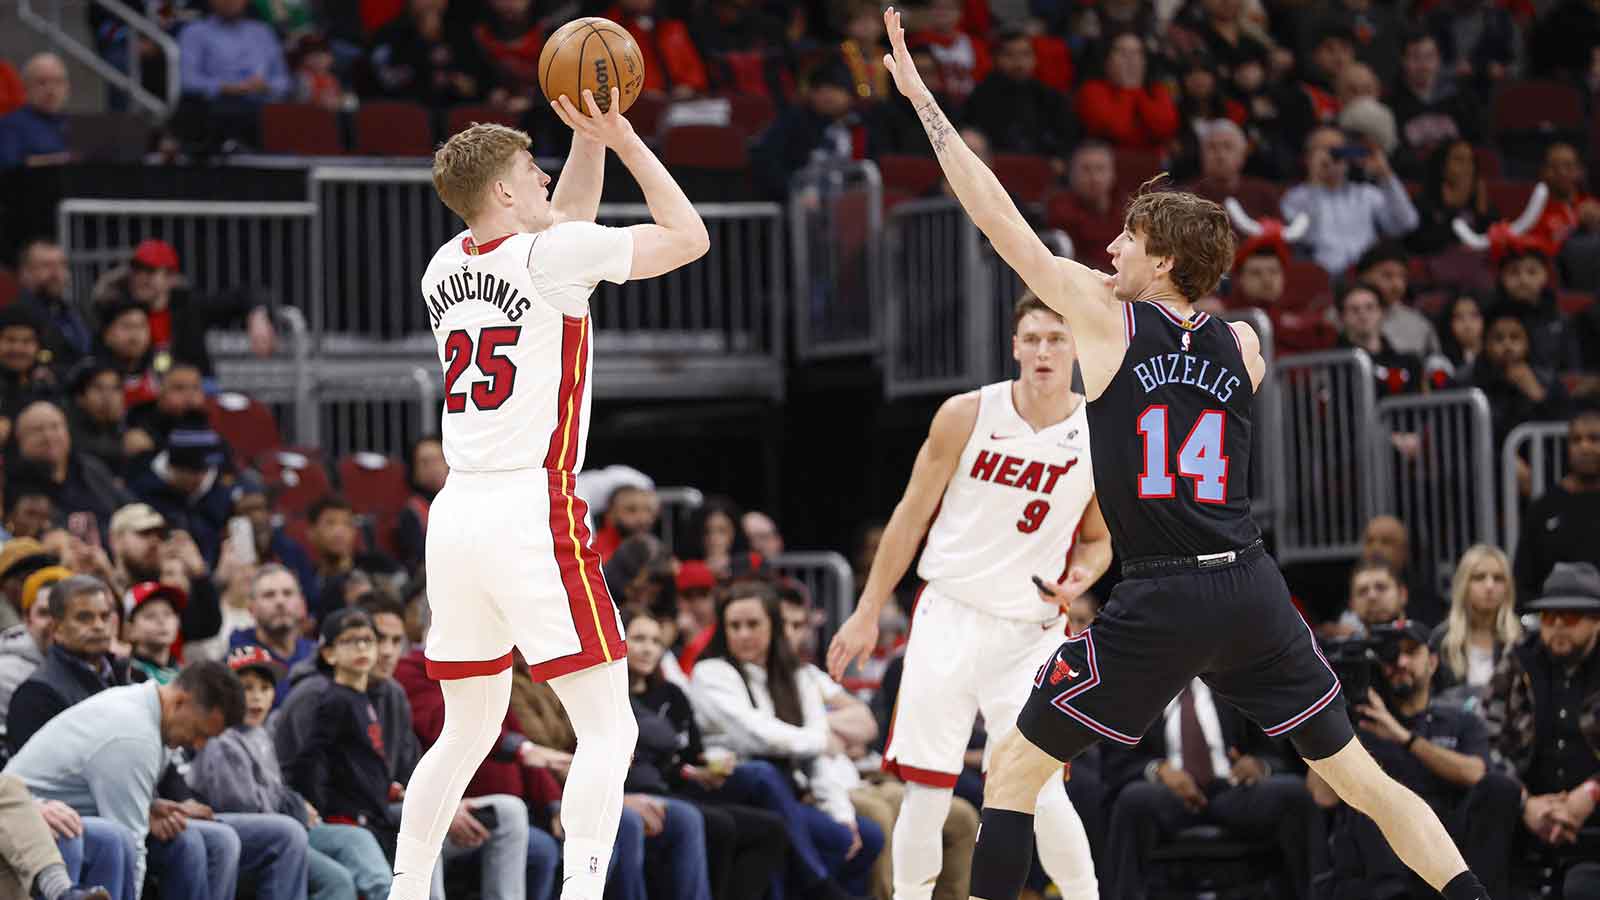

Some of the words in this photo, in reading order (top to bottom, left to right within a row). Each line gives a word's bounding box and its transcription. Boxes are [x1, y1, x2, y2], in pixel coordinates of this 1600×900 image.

[428, 265, 531, 329] JAKUČIONIS
[445, 325, 522, 414] 25
[1133, 353, 1241, 403] BUZELIS
[969, 449, 1079, 495] HEAT
[1136, 404, 1230, 505] 14
[1016, 498, 1050, 535] 9
